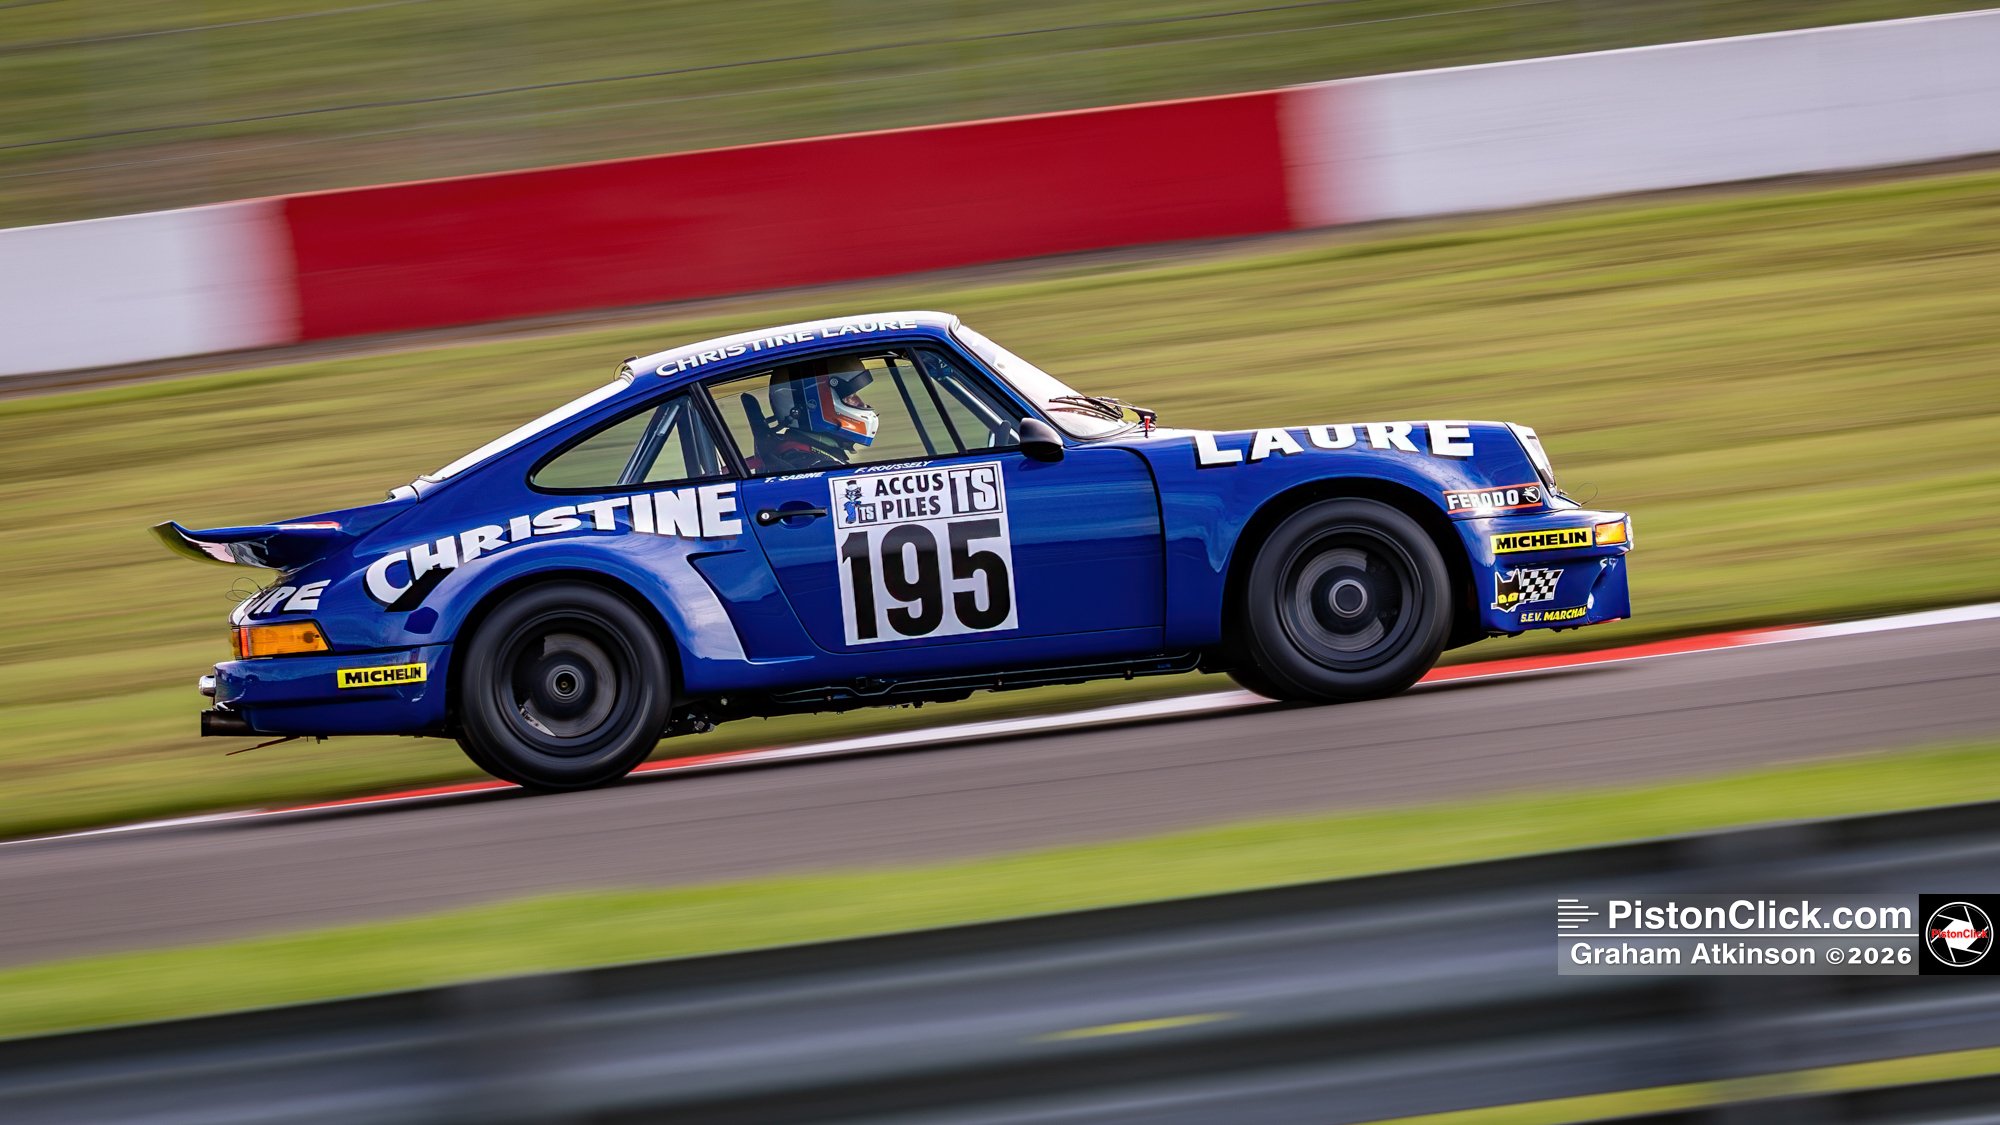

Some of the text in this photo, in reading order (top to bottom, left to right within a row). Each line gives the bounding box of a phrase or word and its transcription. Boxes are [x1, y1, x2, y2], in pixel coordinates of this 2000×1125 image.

[655, 319, 918, 377] CHRISTINE LAURE
[1195, 421, 1475, 465] LAURE
[778, 472, 826, 482] SABINE
[867, 461, 933, 473] ROUSSELY
[875, 473, 944, 497] ACCUS
[951, 468, 997, 512] TS
[882, 496, 941, 520] PILES
[1447, 489, 1519, 510] FERODO
[366, 483, 743, 605] CHRISTINE
[1496, 531, 1588, 550] MICHELIN
[841, 518, 1011, 640] 195
[1543, 605, 1587, 621] MARCHAL
[344, 665, 424, 686] MICHELIN
